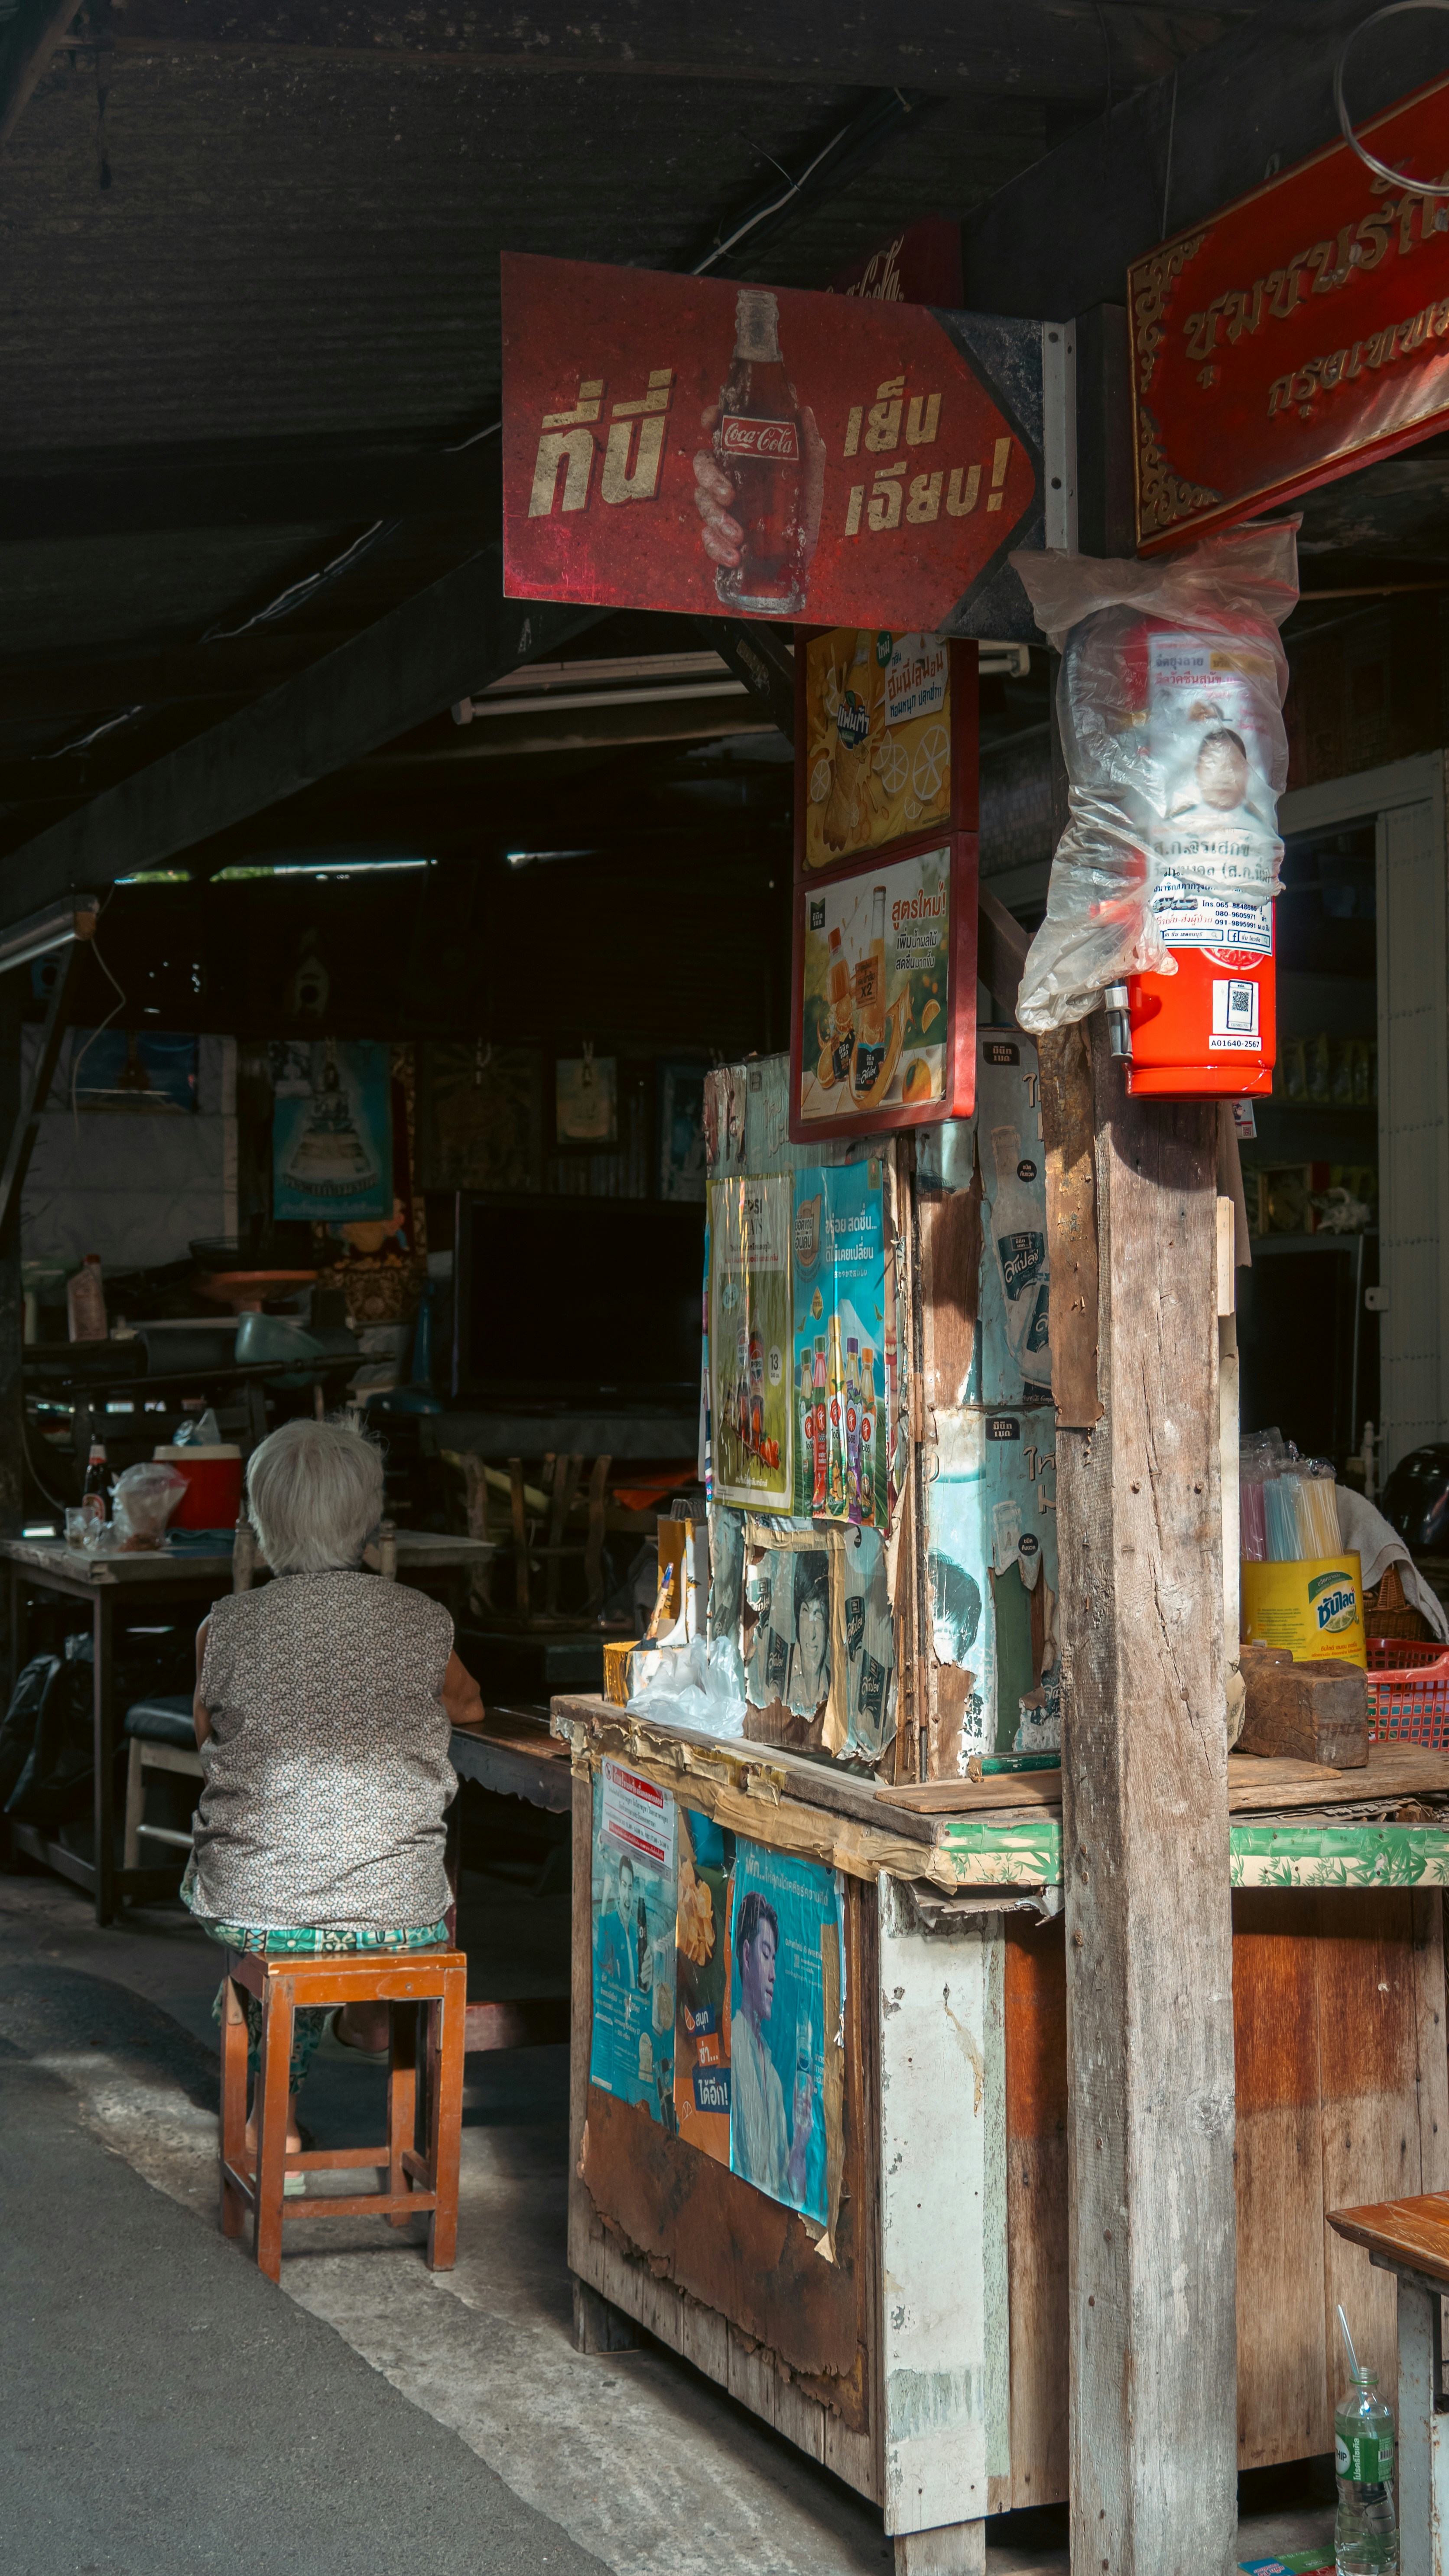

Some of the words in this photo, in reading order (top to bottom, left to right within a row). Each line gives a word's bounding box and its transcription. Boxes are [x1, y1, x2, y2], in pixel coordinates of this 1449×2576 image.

[1183, 154, 1449, 390] ชุมชนรัก
[843, 375, 942, 457] เย็น
[724, 422, 793, 454] Coca-Cola
[845, 437, 1011, 536] เฉียบ!
[877, 635, 890, 659] ใหม่
[892, 881, 946, 930] สูตรใหม่!
[1215, 911, 1256, 920] 080-9605971
[1215, 920, 1256, 929] 091-9895991
[897, 927, 937, 950] เพิ่มน้ำผลไม้
[896, 950, 935, 970] สดชื่นมากขึ้น
[825, 1236, 874, 1262] ดีไม่เคยเปลี่ยน
[695, 2010, 708, 2031] สนุก
[698, 2077, 728, 2105] ได้อีก!
